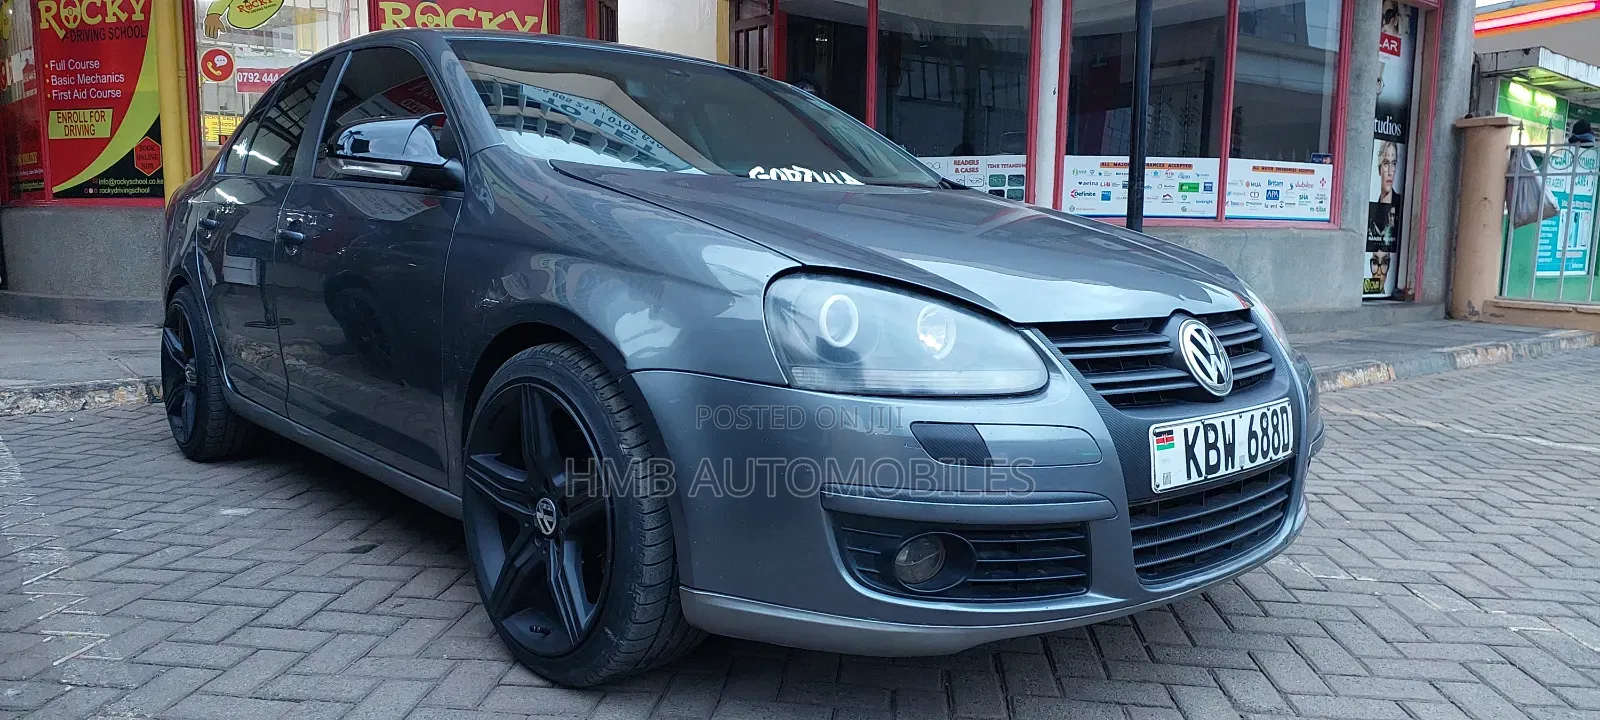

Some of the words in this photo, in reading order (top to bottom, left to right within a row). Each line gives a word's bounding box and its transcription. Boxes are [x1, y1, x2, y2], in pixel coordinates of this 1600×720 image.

[38, 0, 145, 38] ROCKY
[379, 1, 539, 32] ROCKY
[69, 28, 106, 42] DRIVING
[108, 25, 147, 40] SCHOOL
[50, 59, 66, 71] Full
[68, 59, 100, 70] Course
[51, 74, 75, 86] Basic
[77, 72, 125, 84] Mechanics
[237, 72, 260, 83] 0792
[52, 89, 72, 101] First
[73, 88, 87, 99] Aid
[90, 87, 122, 99] Course
[56, 111, 88, 124] ENROLL
[90, 110, 107, 123] FOR
[64, 124, 96, 137] DRIVING
[1374, 115, 1402, 136] tudios
[1183, 418, 1236, 481] KBW
[1247, 405, 1291, 464] 688D
